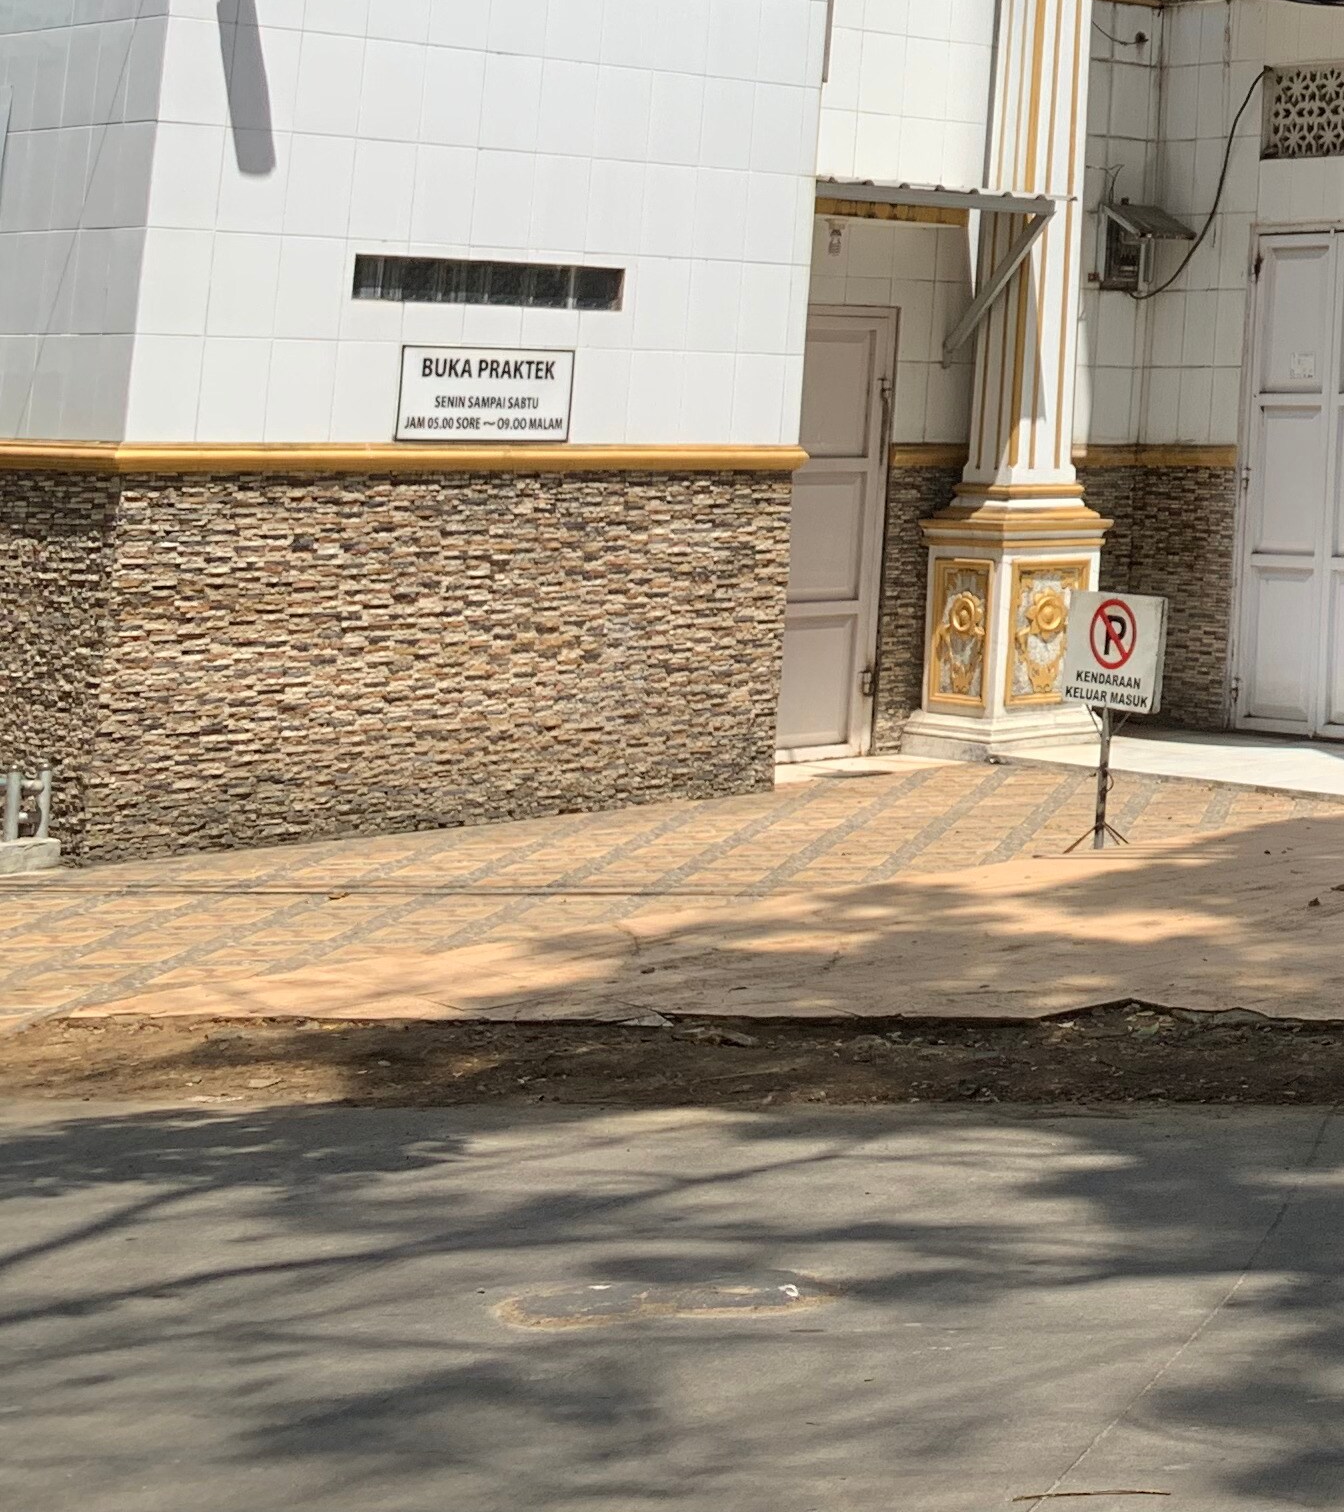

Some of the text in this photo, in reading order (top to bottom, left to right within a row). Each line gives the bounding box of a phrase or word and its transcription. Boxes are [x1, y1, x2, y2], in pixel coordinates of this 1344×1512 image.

[421, 357, 557, 381] BUKA PRAKTEK
[434, 395, 540, 410] SENIN SAMPAI SABTU
[404, 416, 426, 430] JAM
[427, 417, 454, 430] 05.00
[455, 417, 482, 430] SORE
[497, 418, 527, 431] 09.00
[528, 418, 564, 431] MALAM
[1076, 670, 1142, 690] KENDARAAN
[1065, 685, 1149, 709] KELUAR MASUK
